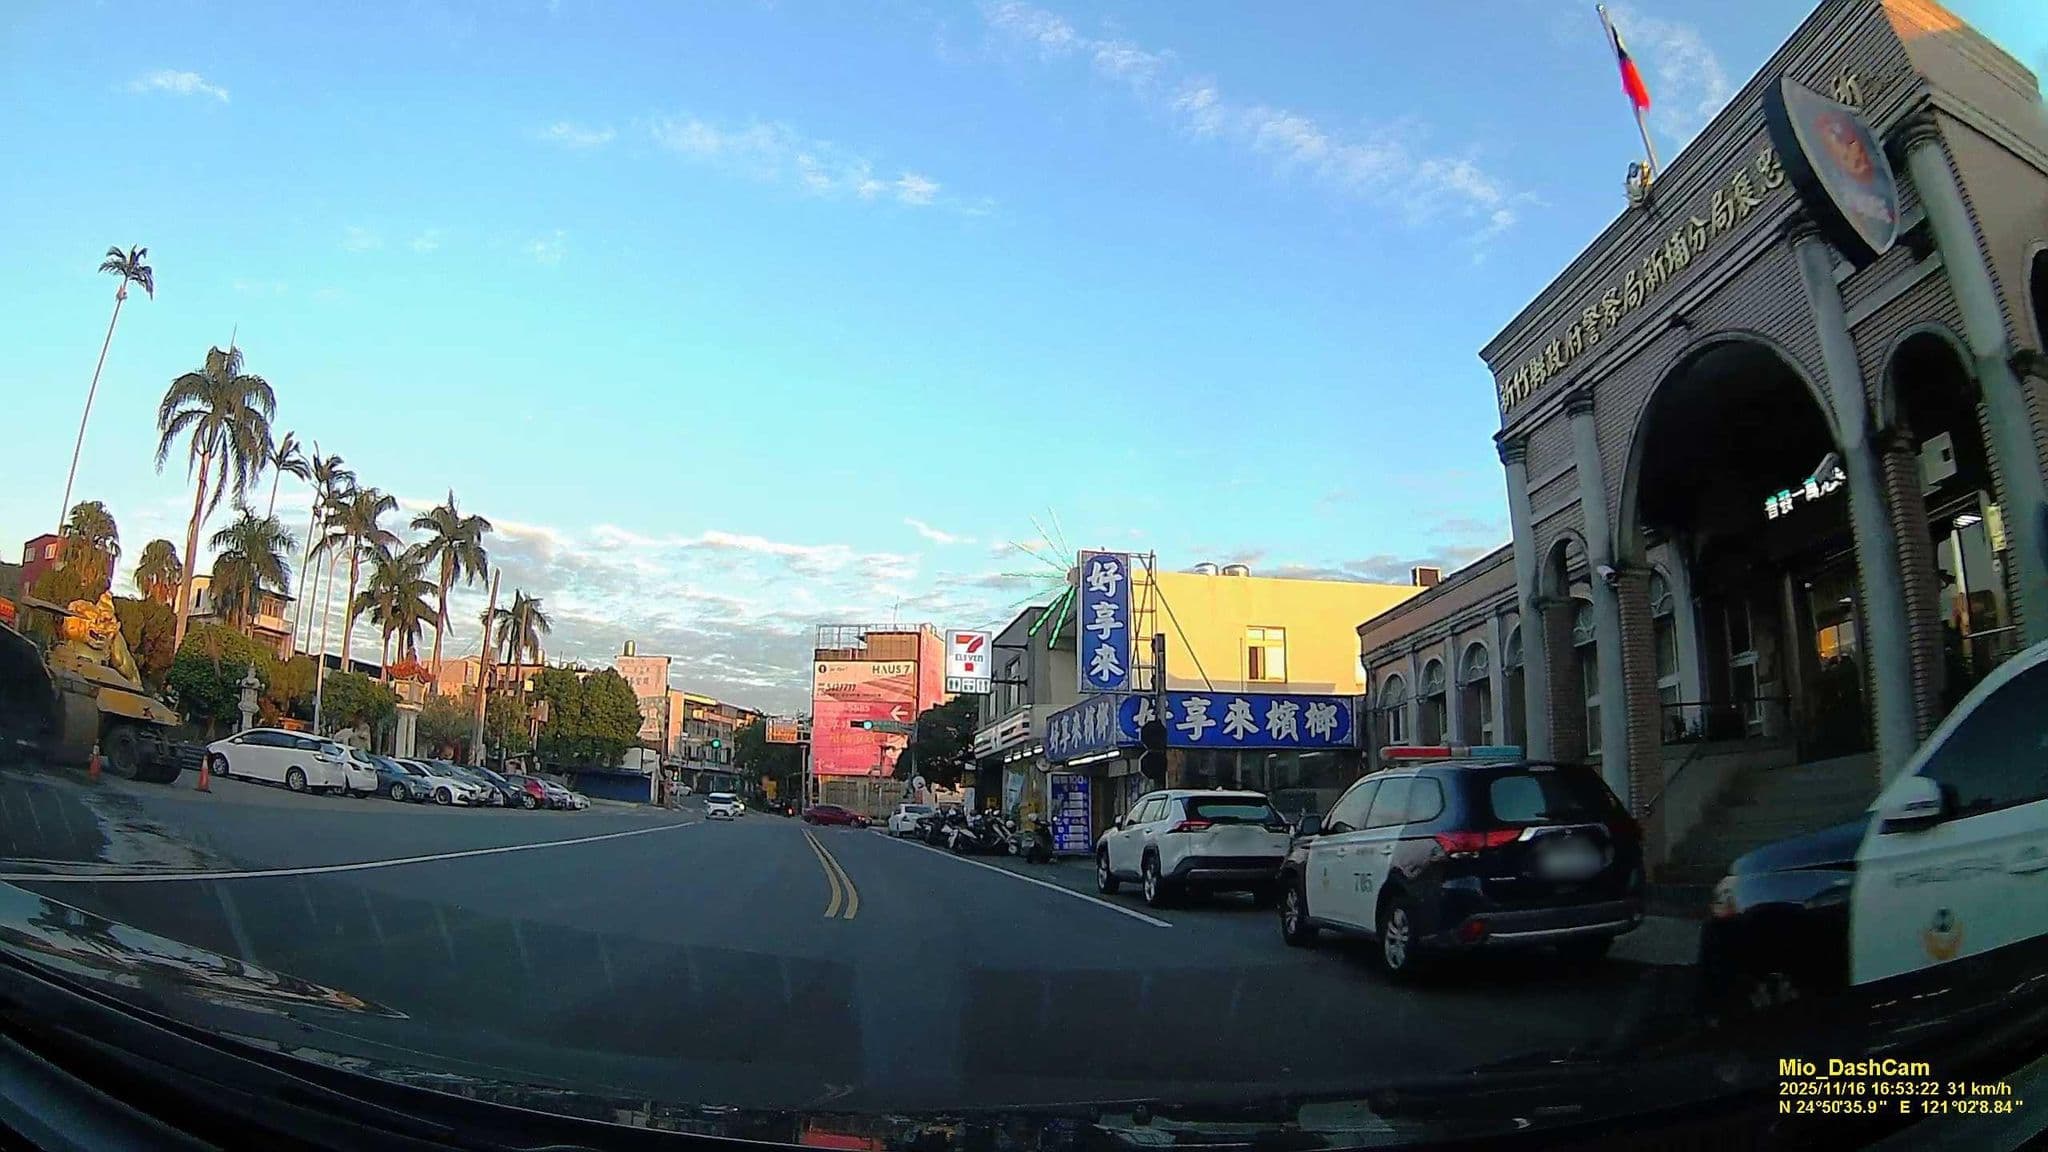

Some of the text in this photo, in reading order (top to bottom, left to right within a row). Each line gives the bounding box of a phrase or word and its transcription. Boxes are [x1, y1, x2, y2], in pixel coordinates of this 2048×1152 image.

[1500, 66, 1864, 412] 新竹縣政府警察局新埔分局褒忠所
[956, 634, 984, 653] 7
[1086, 561, 1125, 683] 好享來
